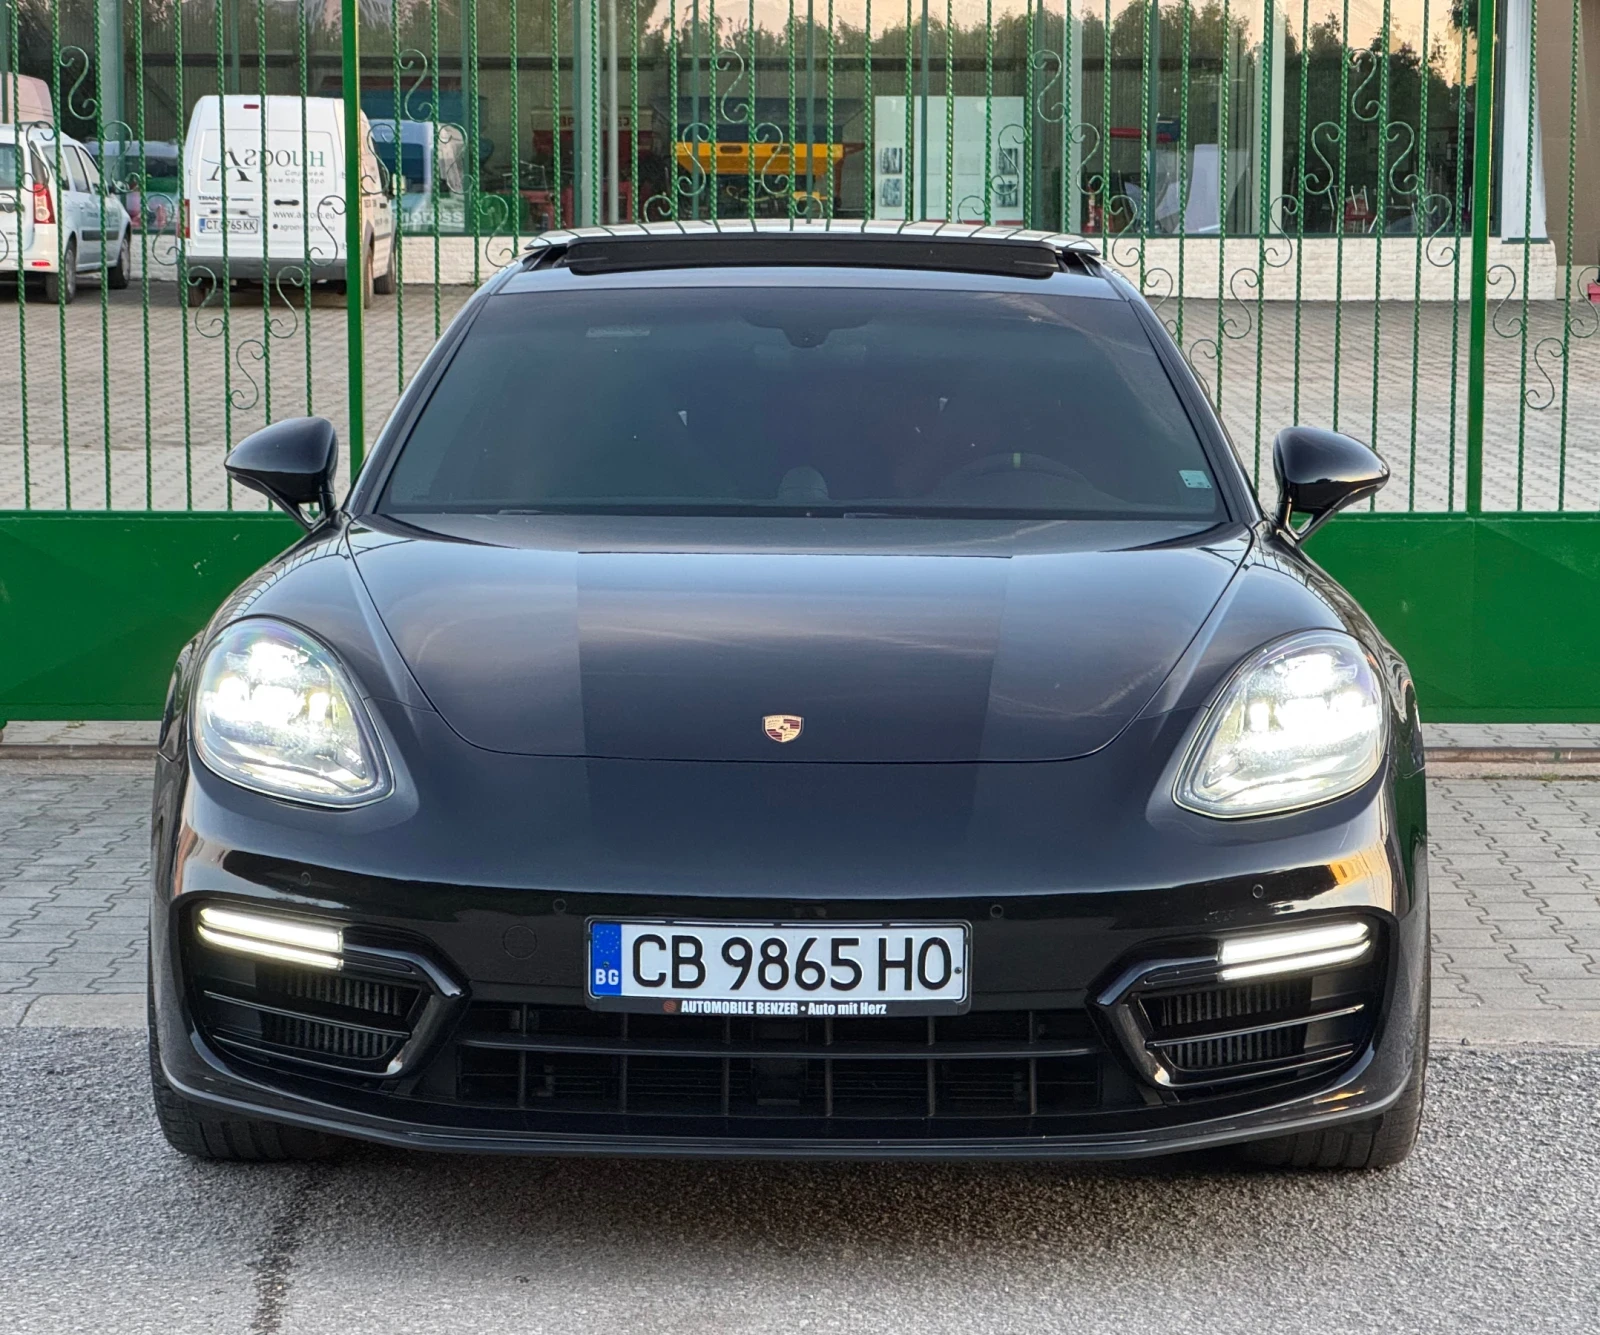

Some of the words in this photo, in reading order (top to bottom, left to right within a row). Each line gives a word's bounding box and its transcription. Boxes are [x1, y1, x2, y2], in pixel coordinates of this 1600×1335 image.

[632, 933, 706, 989] CB
[721, 936, 863, 992] 9865
[878, 936, 951, 992] HO
[595, 968, 619, 986] BG
[680, 1000, 755, 1015] AUTOMOBILE
[755, 1002, 799, 1015] BENZER
[807, 1002, 836, 1015] Auto
[837, 1002, 858, 1015] mit
[859, 1002, 887, 1015] Herz
